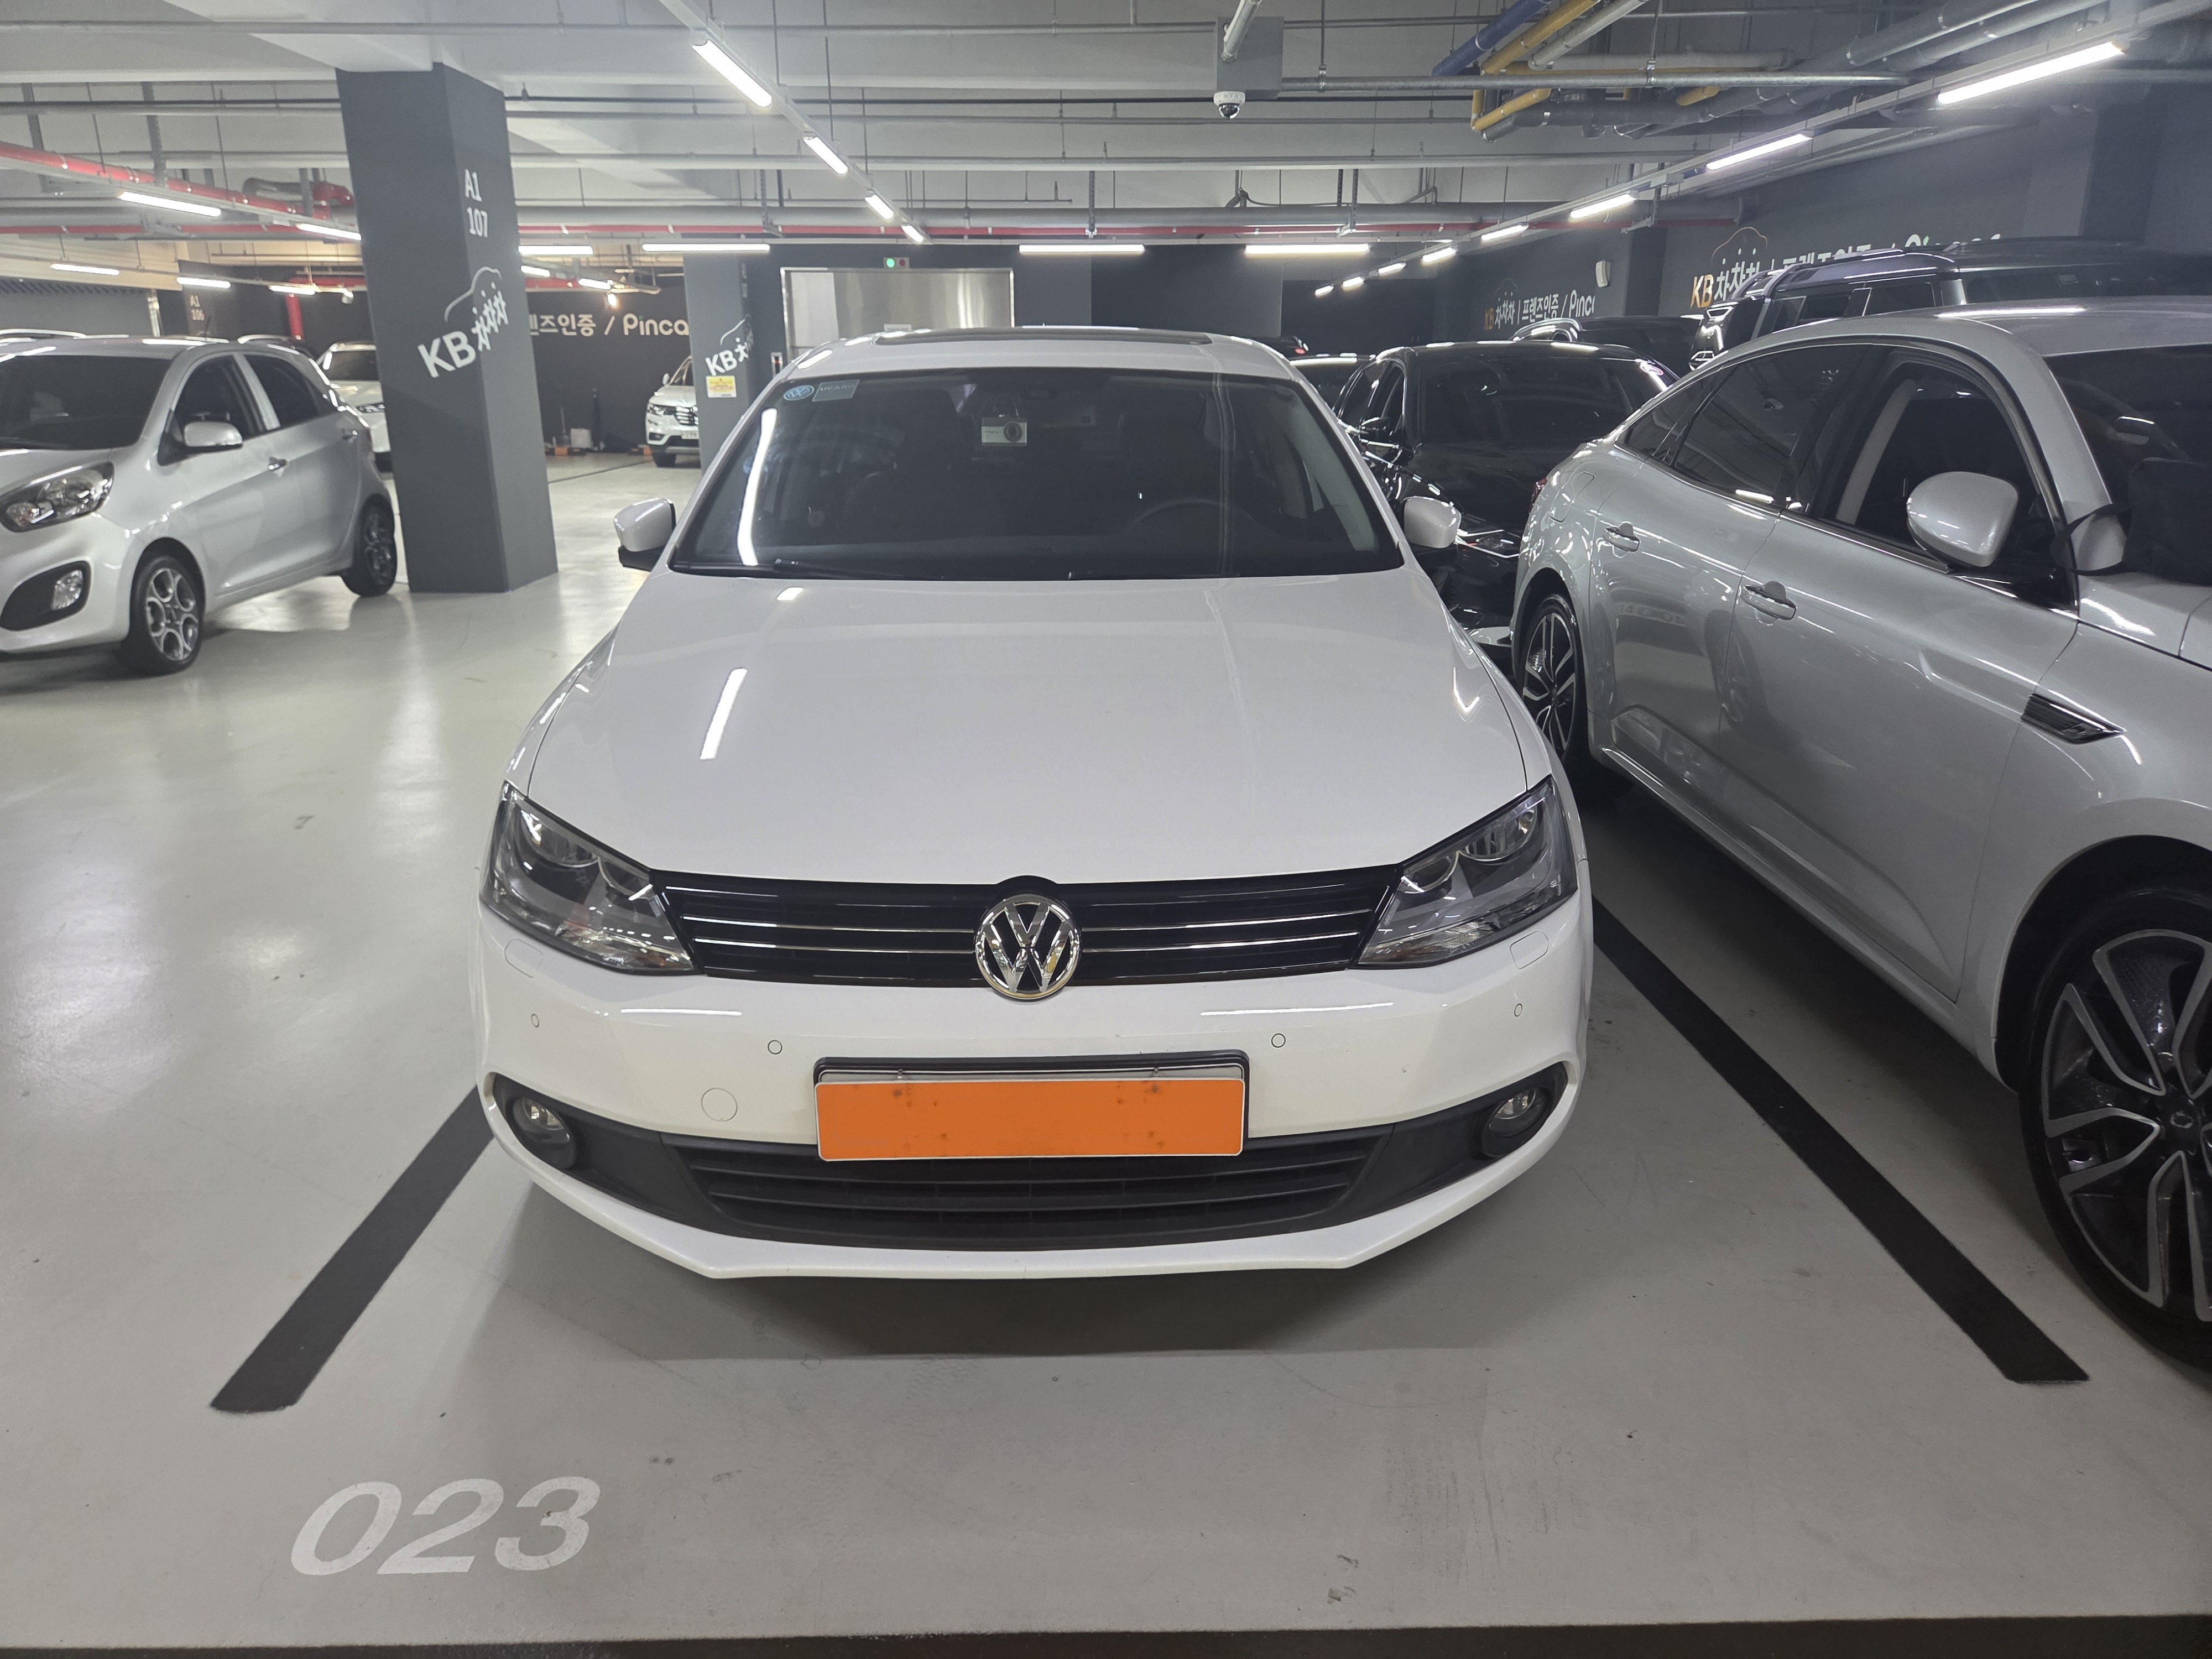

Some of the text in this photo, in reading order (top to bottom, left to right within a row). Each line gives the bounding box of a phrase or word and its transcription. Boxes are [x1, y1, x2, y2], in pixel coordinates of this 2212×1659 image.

[465, 169, 482, 202] A1
[467, 207, 488, 238] 107
[190, 295, 200, 307] A1
[1522, 294, 1559, 322] 프렌즈인증
[291, 1476, 601, 1576] 023
